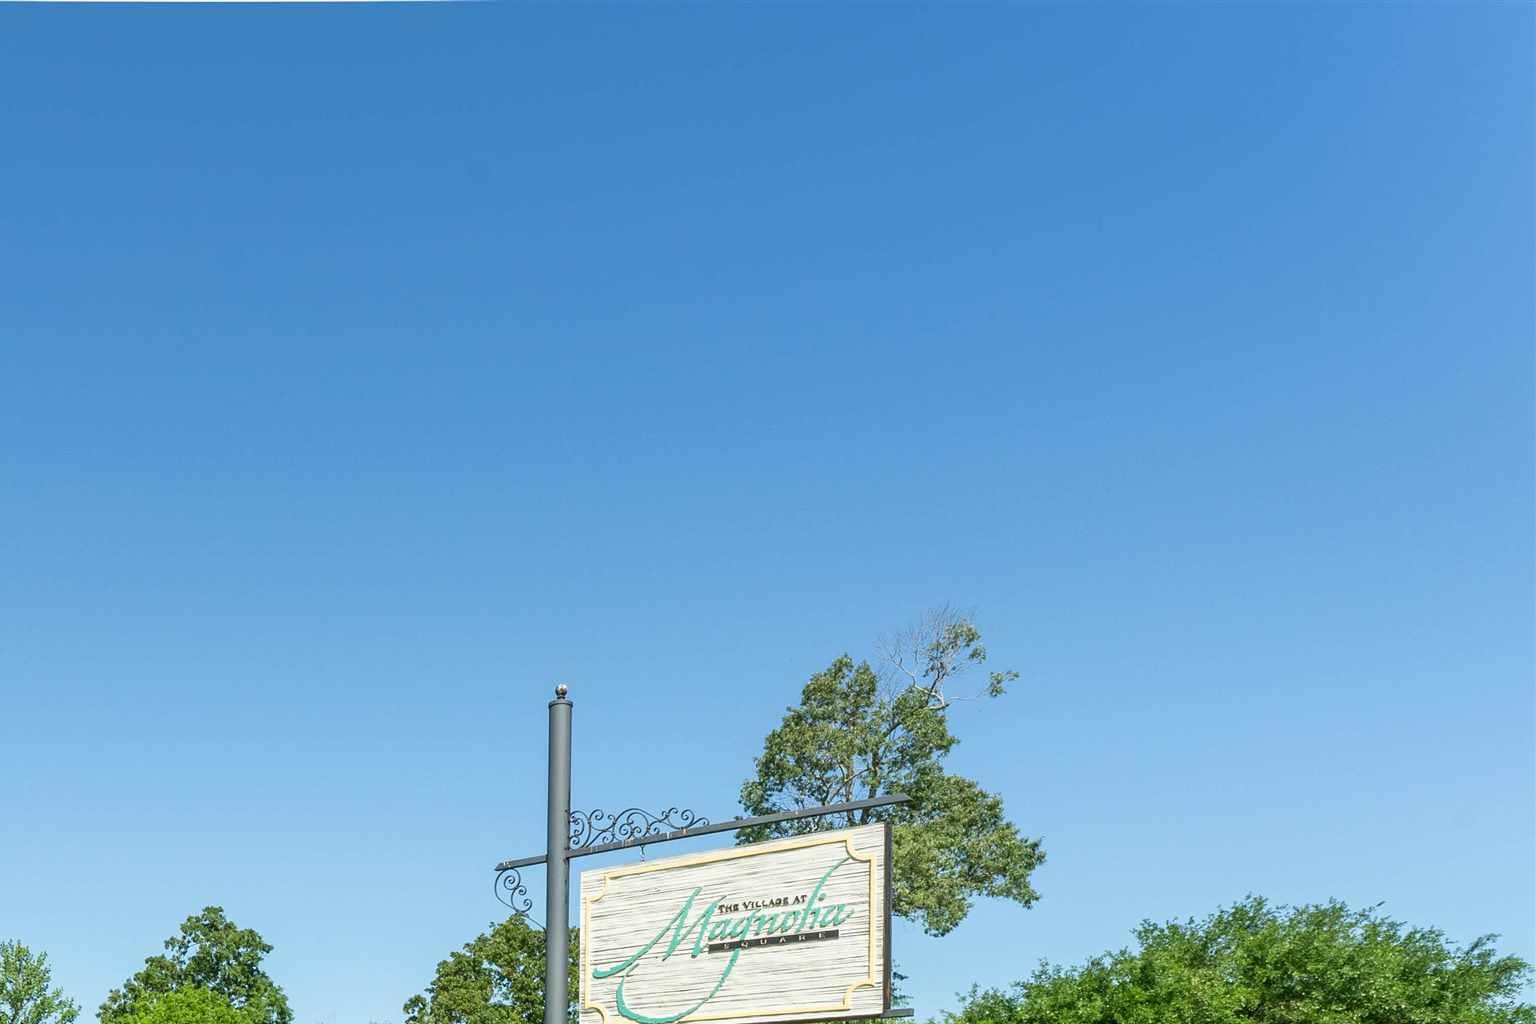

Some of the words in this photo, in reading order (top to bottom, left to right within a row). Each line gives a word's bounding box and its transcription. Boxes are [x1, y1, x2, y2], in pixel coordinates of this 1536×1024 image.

[718, 902, 739, 914] THE
[742, 896, 789, 910] VILLAGE
[791, 894, 808, 906] AT
[723, 931, 827, 950] SQUARE
